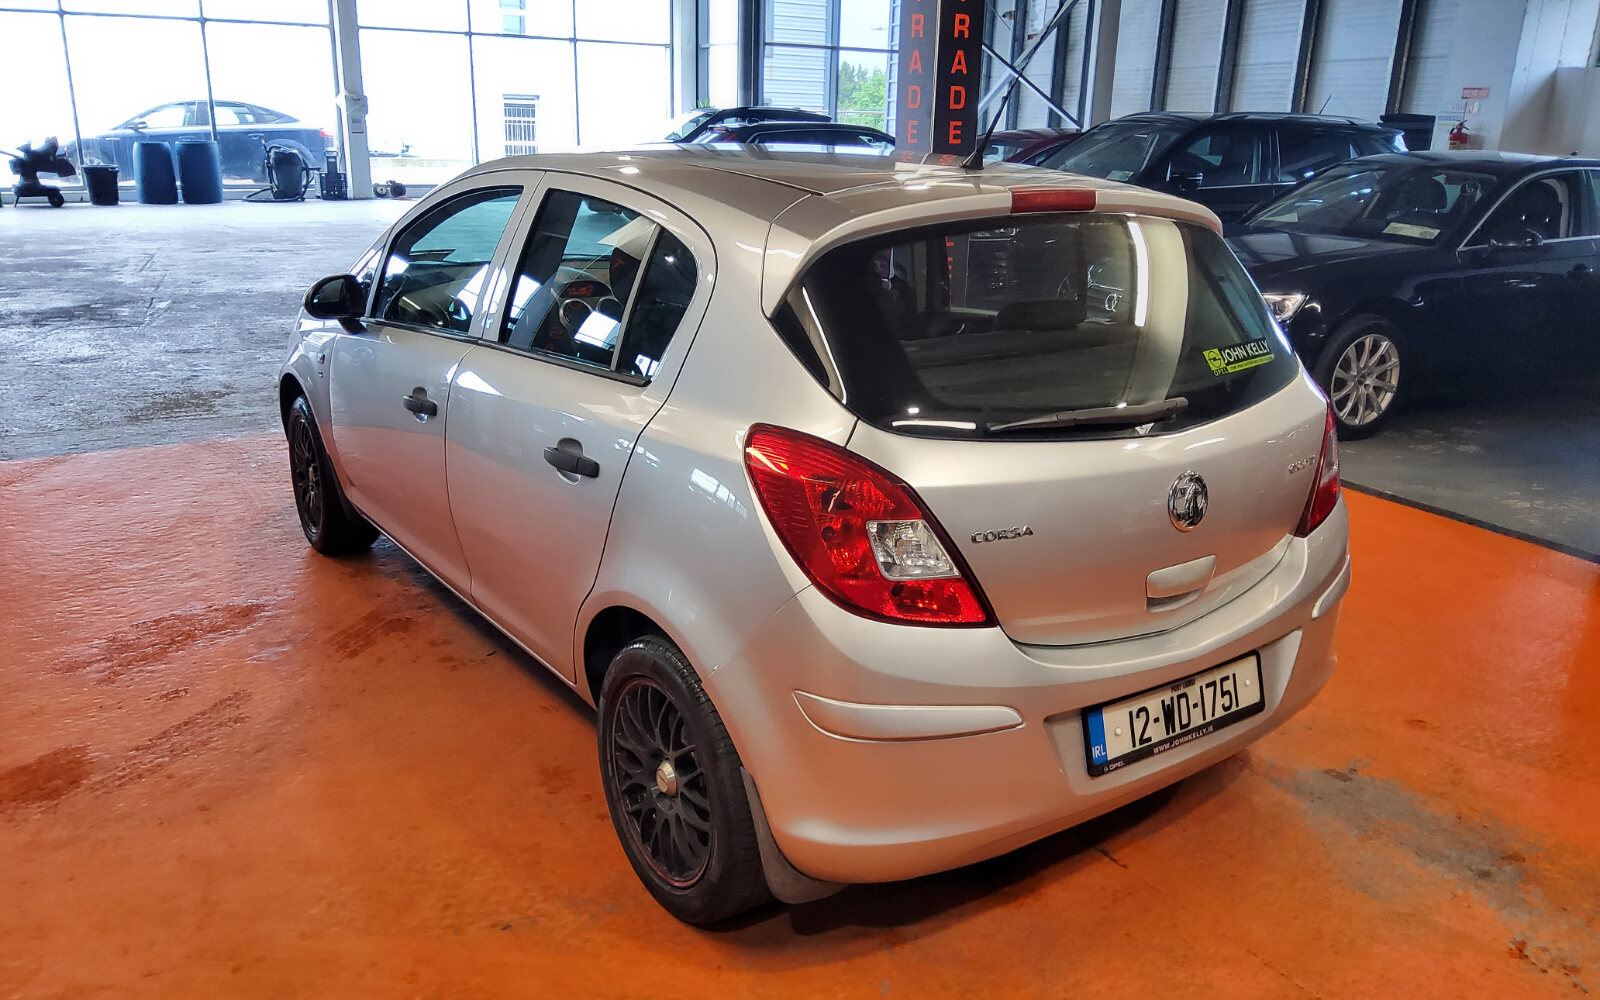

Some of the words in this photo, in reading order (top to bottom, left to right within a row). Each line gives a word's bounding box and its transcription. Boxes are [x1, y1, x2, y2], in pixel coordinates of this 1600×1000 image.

[907, 0, 925, 143] RADE
[948, 0, 970, 144] RADE
[1221, 345, 1248, 363] JOHN
[1245, 340, 1270, 356] KELLY
[1213, 367, 1228, 377] OPEL
[971, 525, 1034, 544] CORSA
[1129, 673, 1239, 748] 12-WD-1751
[1092, 744, 1106, 759] IRL
[1109, 761, 1125, 770] OPEL
